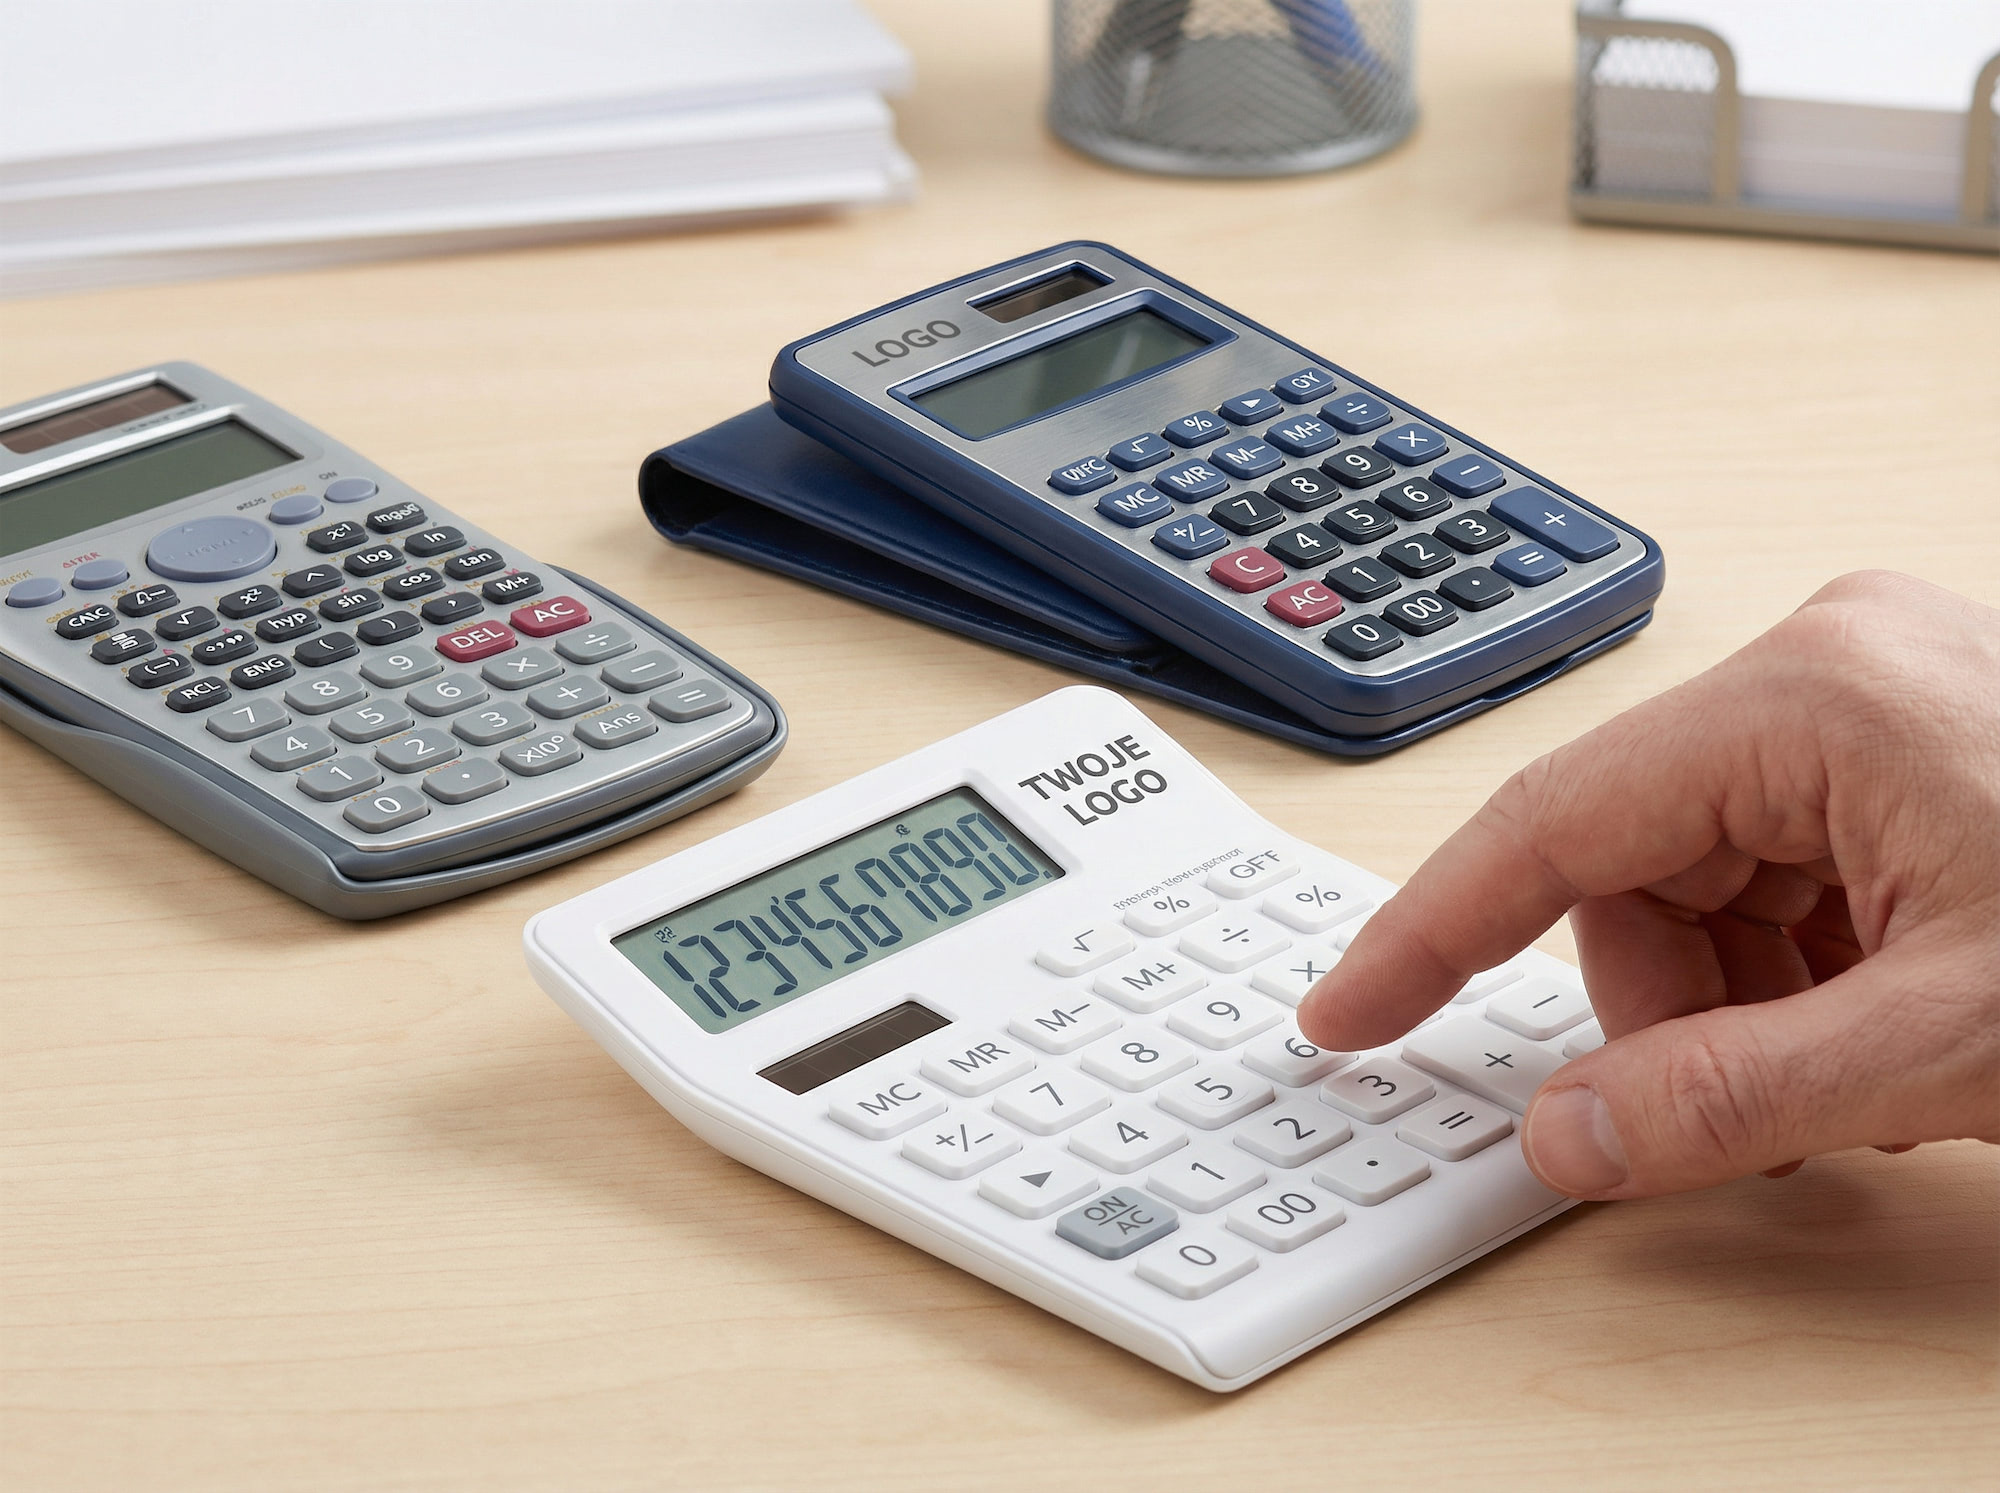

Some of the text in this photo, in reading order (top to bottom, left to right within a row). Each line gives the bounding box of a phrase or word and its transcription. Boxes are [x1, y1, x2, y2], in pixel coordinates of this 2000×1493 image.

[851, 319, 961, 368] LOGO
[1282, 421, 1322, 442] M+
[1345, 454, 1371, 472] 9
[1170, 465, 1217, 488] MR
[1290, 476, 1320, 494] 8
[1114, 488, 1160, 513] MC
[1402, 485, 1430, 503] 6
[1231, 499, 1258, 517] 7
[1345, 507, 1374, 527] 5
[1458, 518, 1486, 537] 3
[1295, 532, 1319, 551] 4
[1404, 542, 1436, 561] 2
[357, 549, 394, 565] log
[458, 552, 493, 567] tan
[1235, 555, 1265, 574] C
[399, 571, 432, 588] cos
[495, 576, 530, 592] M+
[1351, 566, 1377, 583] 1
[338, 592, 367, 608] sin
[1290, 585, 1330, 611] AC
[533, 602, 575, 623] AC
[1402, 597, 1444, 620] 00
[267, 612, 308, 629] hyp
[450, 627, 504, 649] DEL
[1351, 624, 1379, 643] 0
[388, 655, 414, 671] 9
[312, 680, 341, 697] 8
[436, 681, 462, 698] 6
[232, 706, 256, 724] 7
[356, 707, 385, 725] 5
[480, 712, 508, 728] 3
[598, 711, 642, 734] Ans
[285, 736, 309, 752] 4
[404, 738, 435, 756] 2
[329, 765, 353, 782] 1
[1018, 734, 1151, 801] TWOJE
[373, 796, 401, 814] 0
[1062, 768, 1168, 826] LOGO
[1121, 960, 1177, 992] M+
[1207, 1000, 1241, 1023] 9
[947, 1041, 1011, 1074] MR
[1120, 1041, 1160, 1064] 8
[1284, 1036, 1320, 1059] 6
[1029, 1082, 1064, 1107] 7
[1194, 1077, 1234, 1101] 5
[1357, 1074, 1397, 1097] 3
[856, 1082, 922, 1116] MC
[1115, 1120, 1149, 1145] 4
[1273, 1117, 1317, 1140] 2
[1191, 1160, 1226, 1181] 1
[1083, 1196, 1129, 1221] ON
[1257, 1192, 1318, 1226] 00
[1117, 1209, 1154, 1236] AC
[1179, 1244, 1217, 1267] 0
